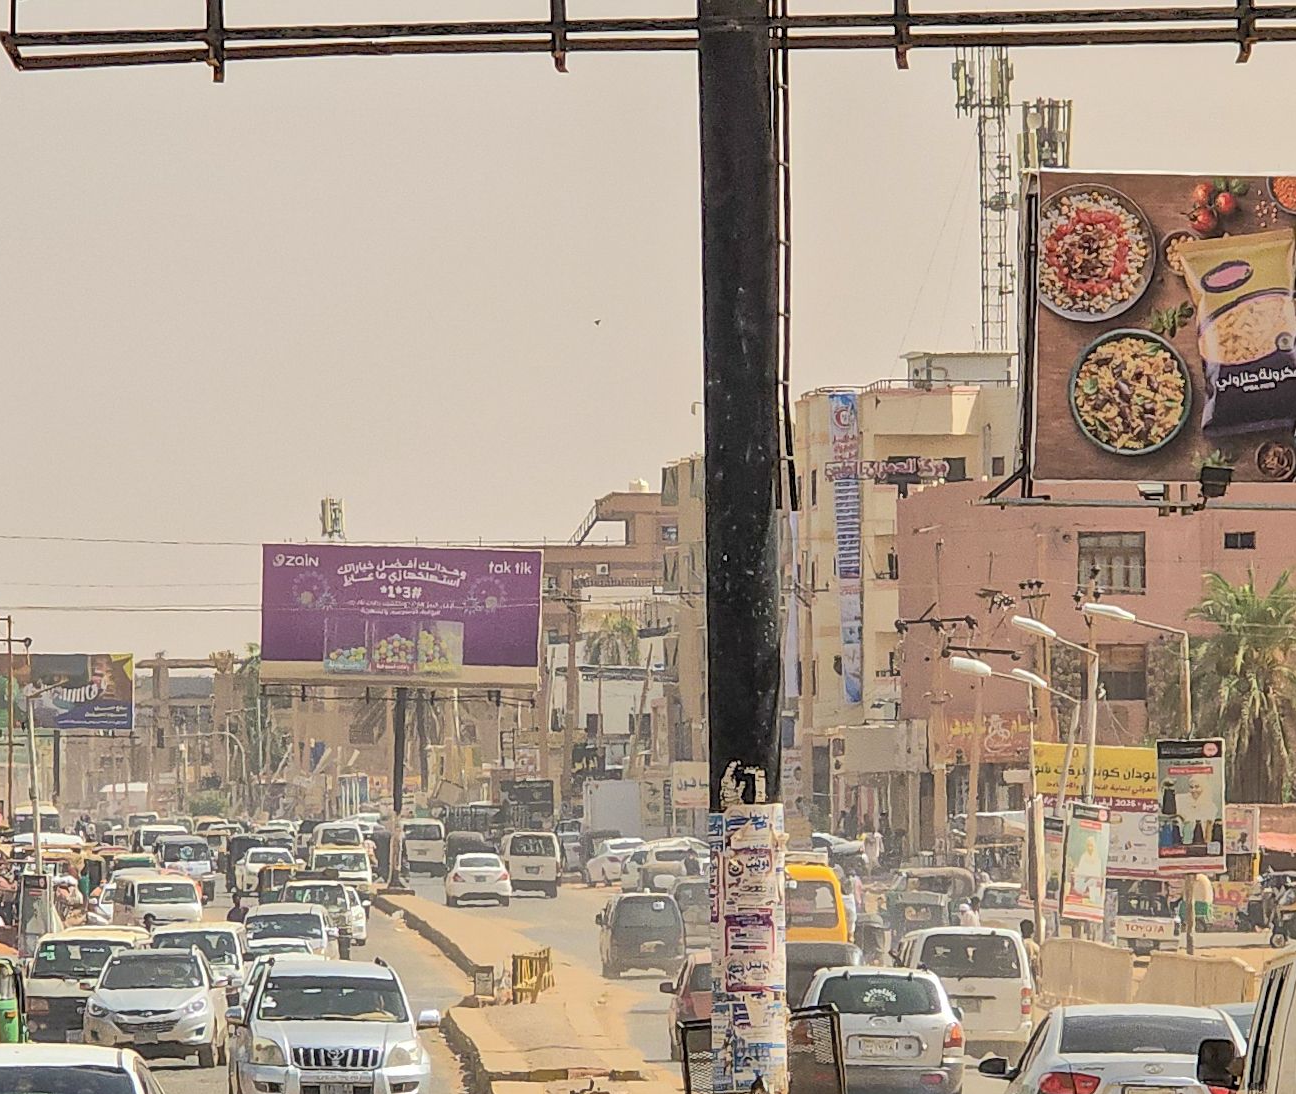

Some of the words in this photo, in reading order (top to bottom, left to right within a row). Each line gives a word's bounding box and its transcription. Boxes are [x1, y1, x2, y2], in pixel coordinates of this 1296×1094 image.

[284, 553, 320, 567] zain
[488, 561, 511, 574] tak
[515, 561, 533, 575] tik
[1125, 923, 1165, 934] TOYOTA
